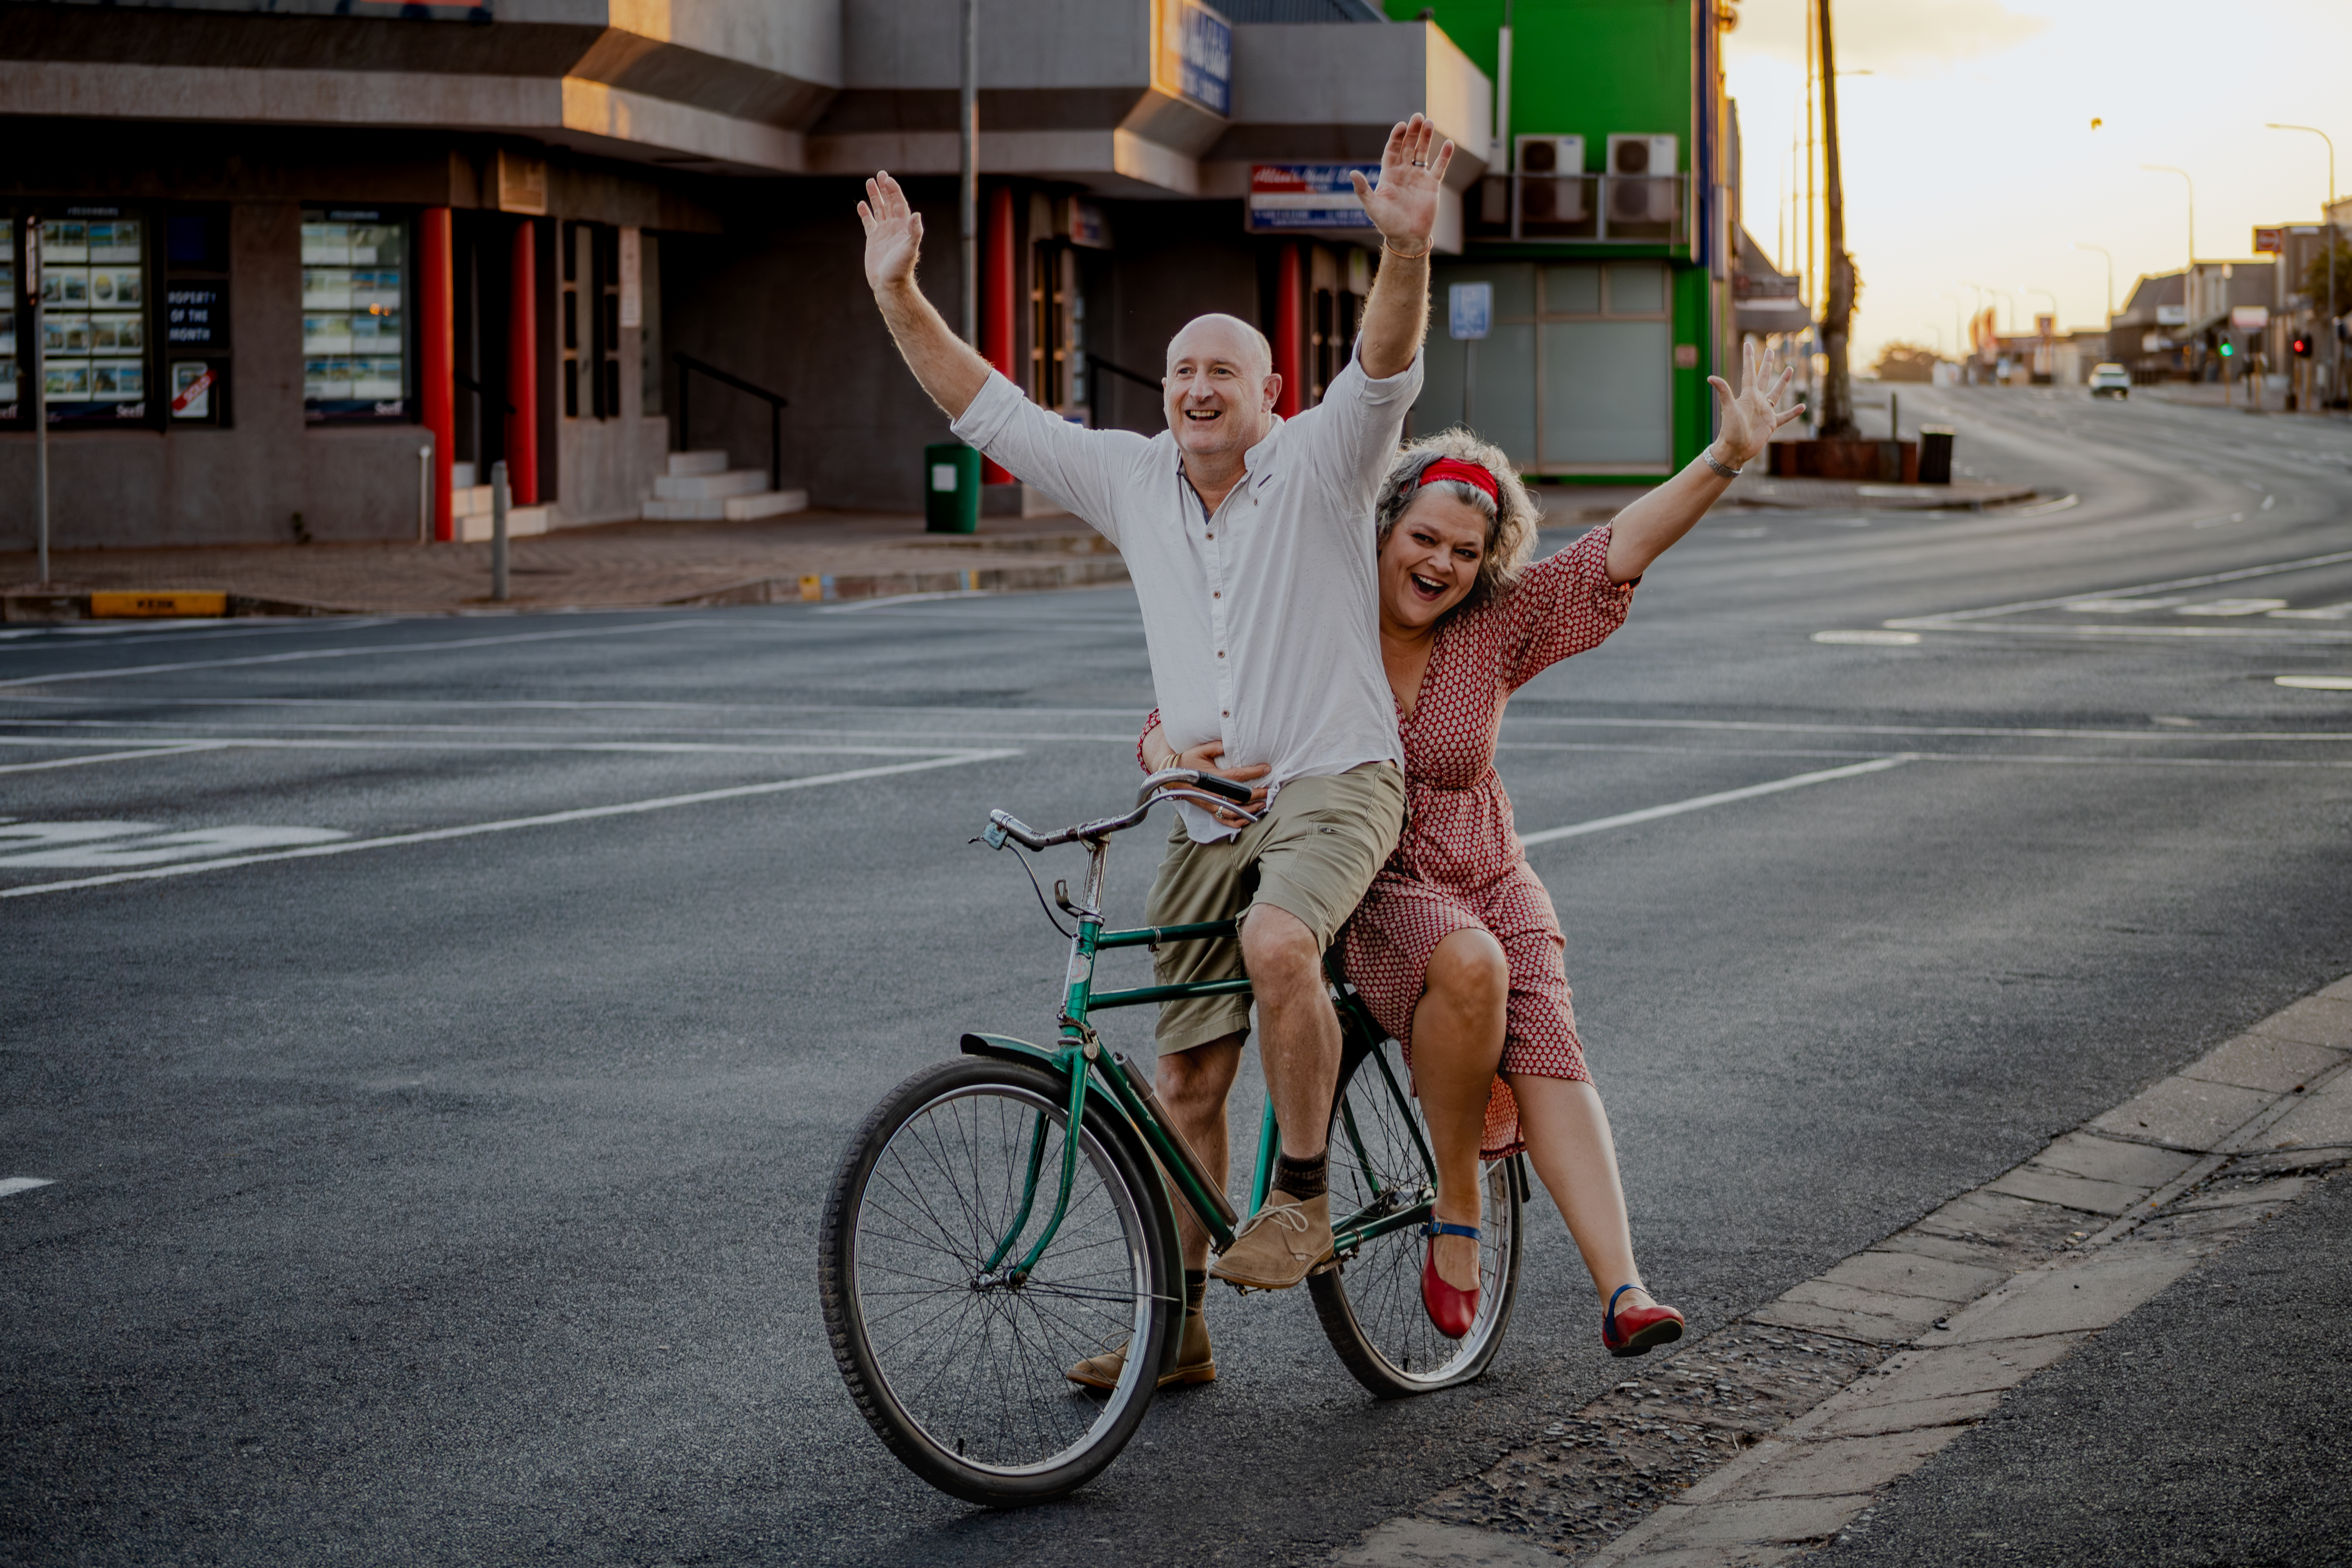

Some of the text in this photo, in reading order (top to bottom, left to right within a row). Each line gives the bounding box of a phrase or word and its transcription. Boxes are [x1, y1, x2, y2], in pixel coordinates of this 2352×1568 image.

[168, 290, 216, 305] ROPERTY
[170, 308, 209, 323] OF THE
[169, 327, 211, 342] MONTH
